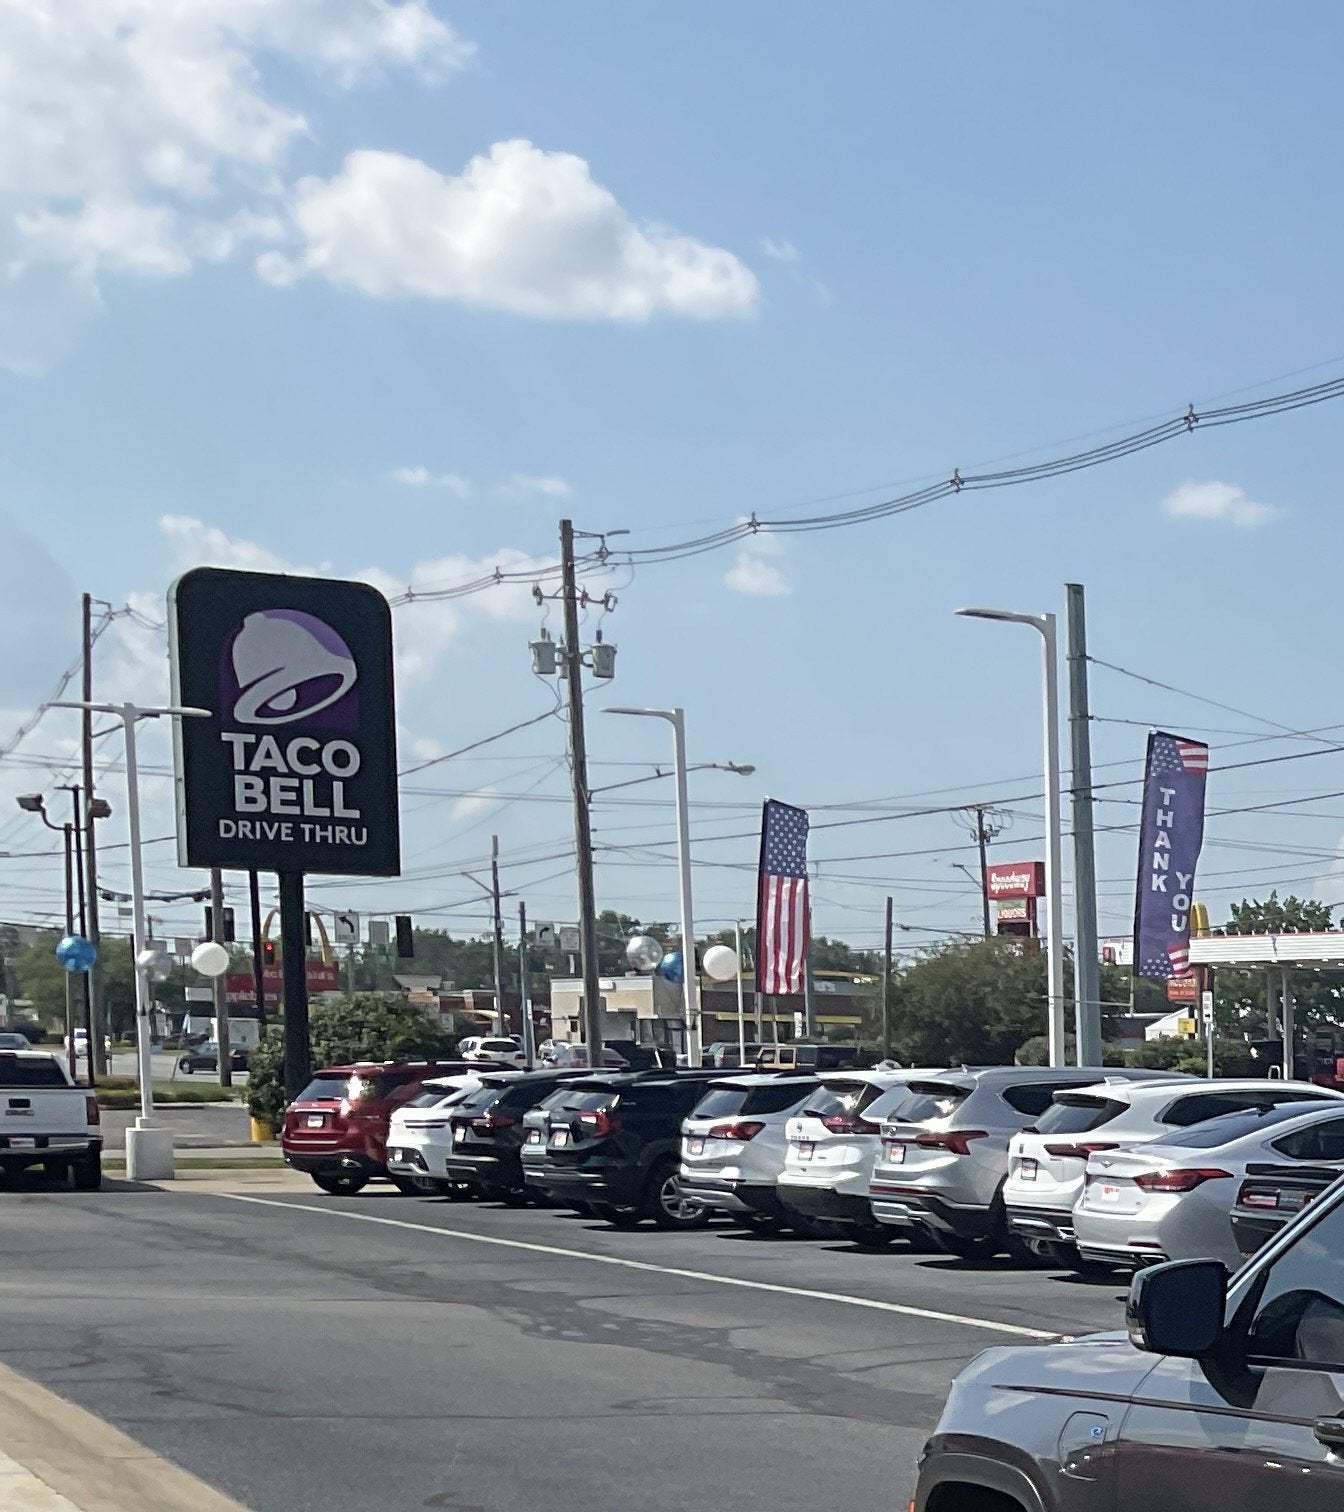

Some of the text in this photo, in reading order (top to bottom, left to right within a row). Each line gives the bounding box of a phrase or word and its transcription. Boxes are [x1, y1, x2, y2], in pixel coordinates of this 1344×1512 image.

[220, 731, 361, 778] TACO
[234, 774, 361, 819] BELL
[219, 818, 368, 846] DRIVE THRU
[1151, 787, 1176, 893] THANK
[1171, 871, 1192, 933] YOU
